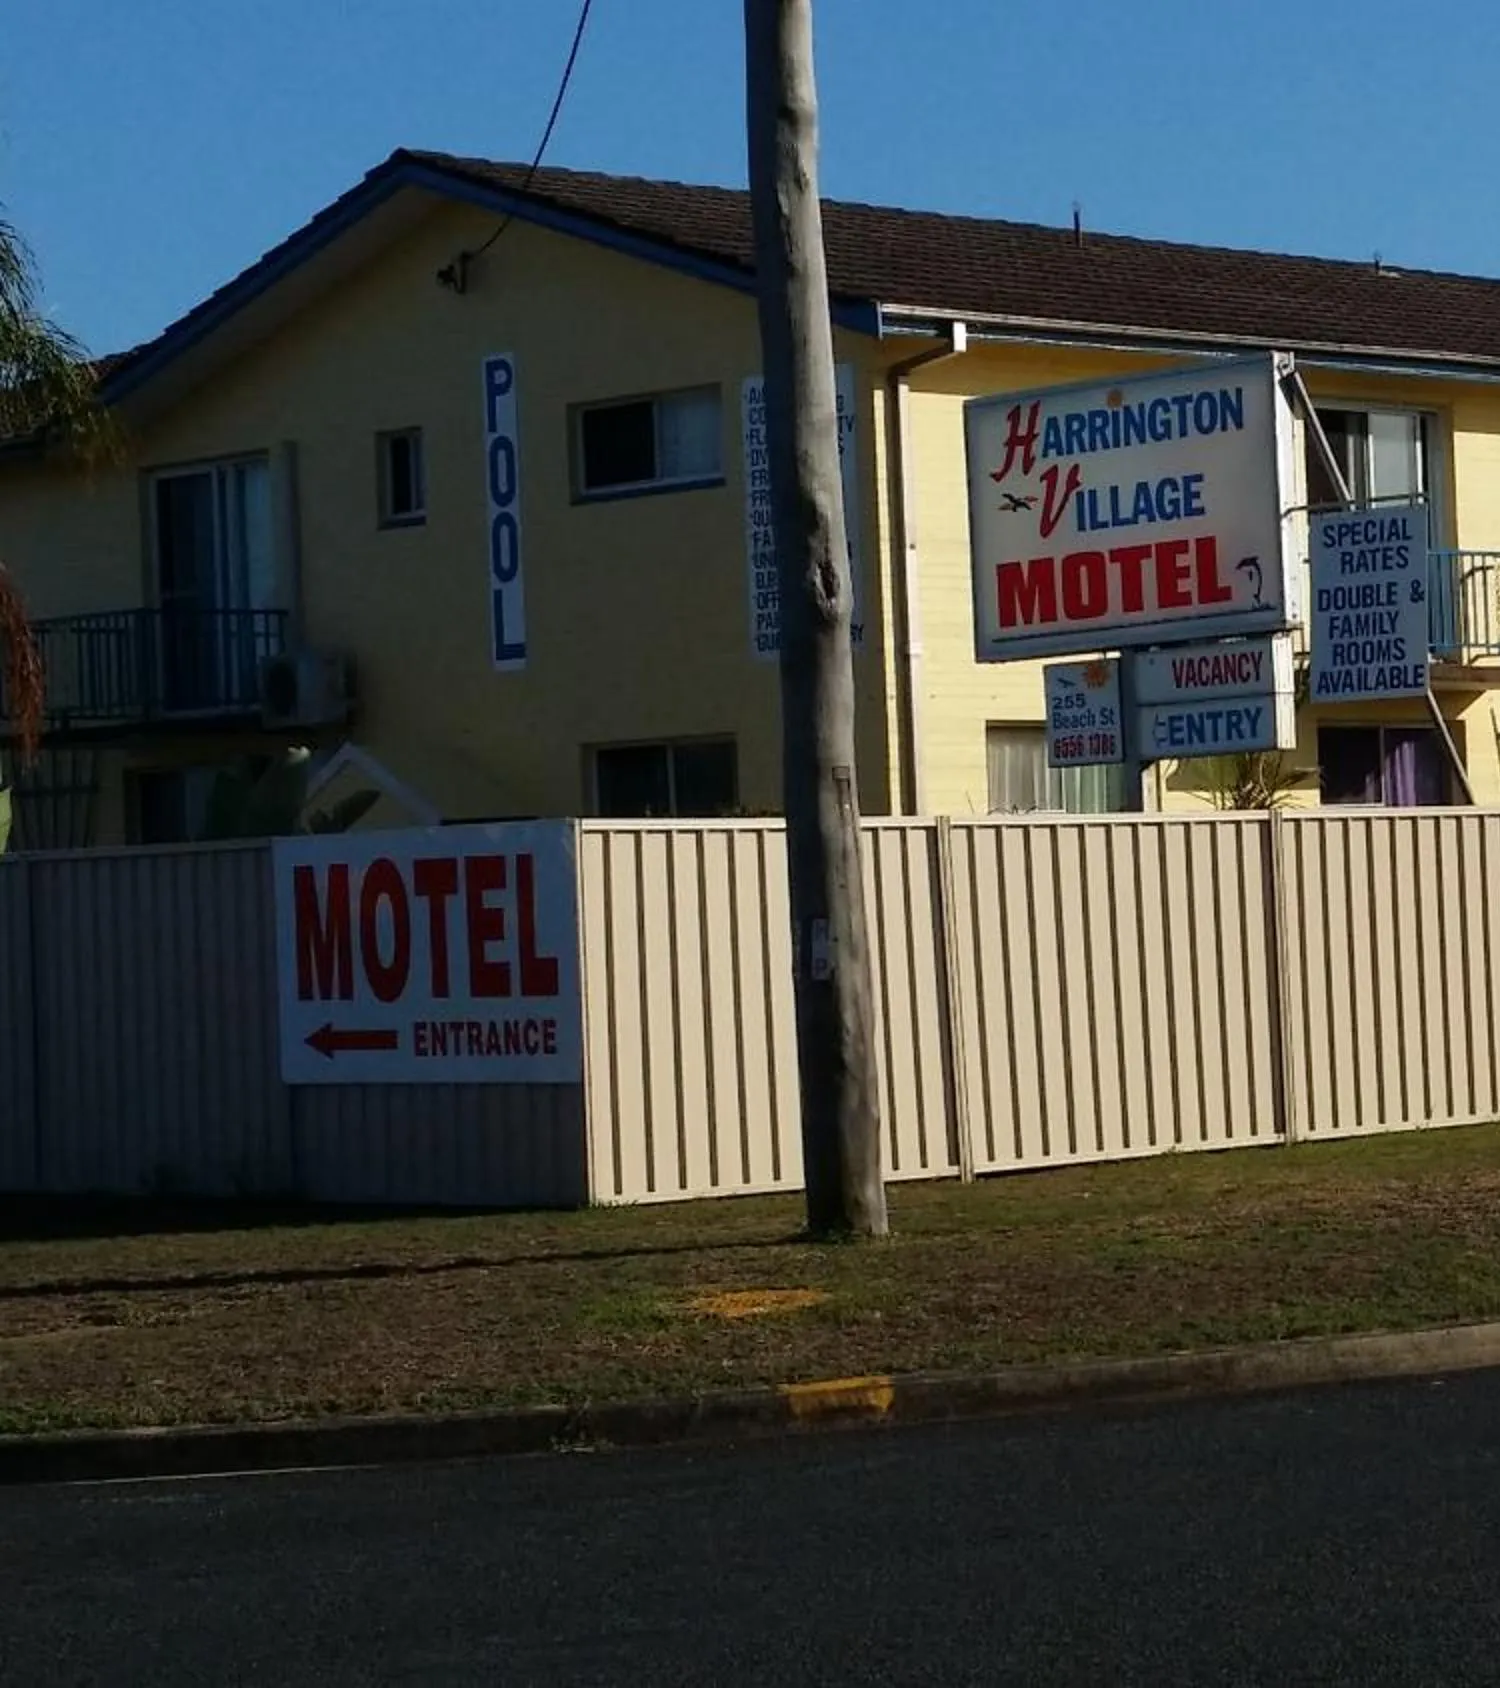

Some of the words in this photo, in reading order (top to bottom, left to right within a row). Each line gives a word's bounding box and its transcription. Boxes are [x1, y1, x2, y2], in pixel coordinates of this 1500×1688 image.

[989, 387, 1244, 483] HARRINGTON
[486, 358, 527, 660] POOL
[1038, 463, 1206, 539] VILLAGE
[1322, 516, 1414, 548] SPECIAL
[1340, 545, 1410, 575] RATES
[996, 535, 1233, 629] MOTEL
[1317, 582, 1399, 612] DOUBLE
[1408, 579, 1425, 603] &
[1328, 610, 1400, 641] FAMILY
[1172, 650, 1264, 688] VACANCY
[1331, 638, 1406, 667] ROOMS
[1316, 663, 1425, 695] AVAILABLE
[1052, 708, 1096, 730] Beach
[1099, 706, 1116, 726] St
[1169, 707, 1263, 746] ENTRY
[293, 853, 560, 1003] MOTEL
[413, 1018, 558, 1057] ENTRANCE
